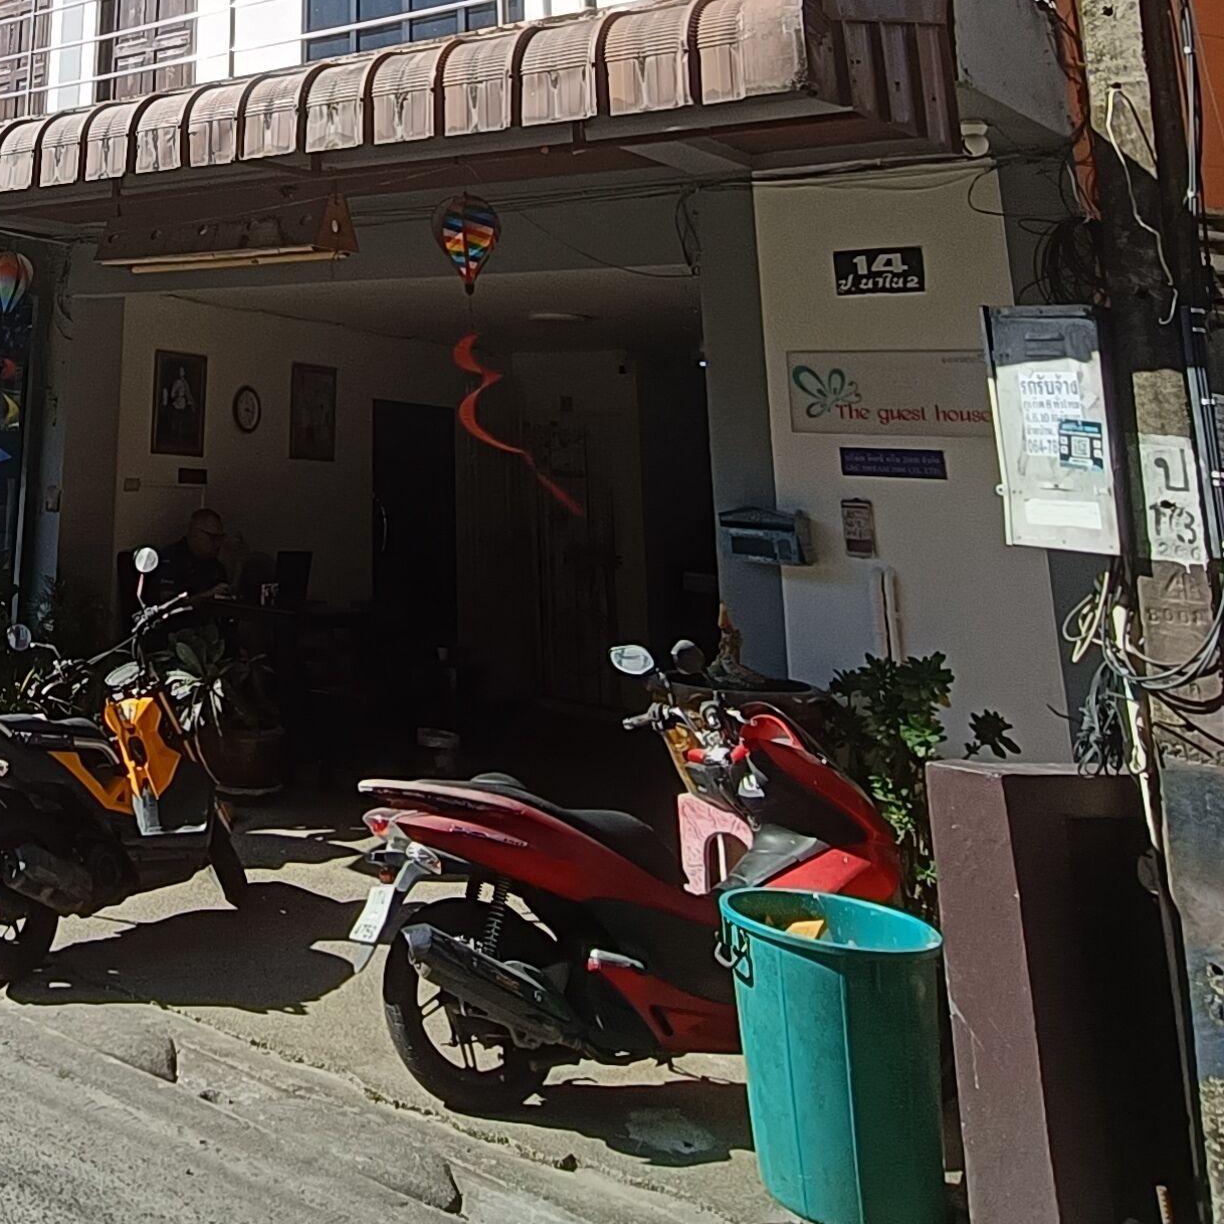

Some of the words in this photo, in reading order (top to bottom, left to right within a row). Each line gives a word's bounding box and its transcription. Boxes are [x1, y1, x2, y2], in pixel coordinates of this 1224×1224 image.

[853, 252, 908, 275] 14
[835, 404, 870, 420] The
[878, 407, 926, 425] guest
[935, 405, 993, 424] house
